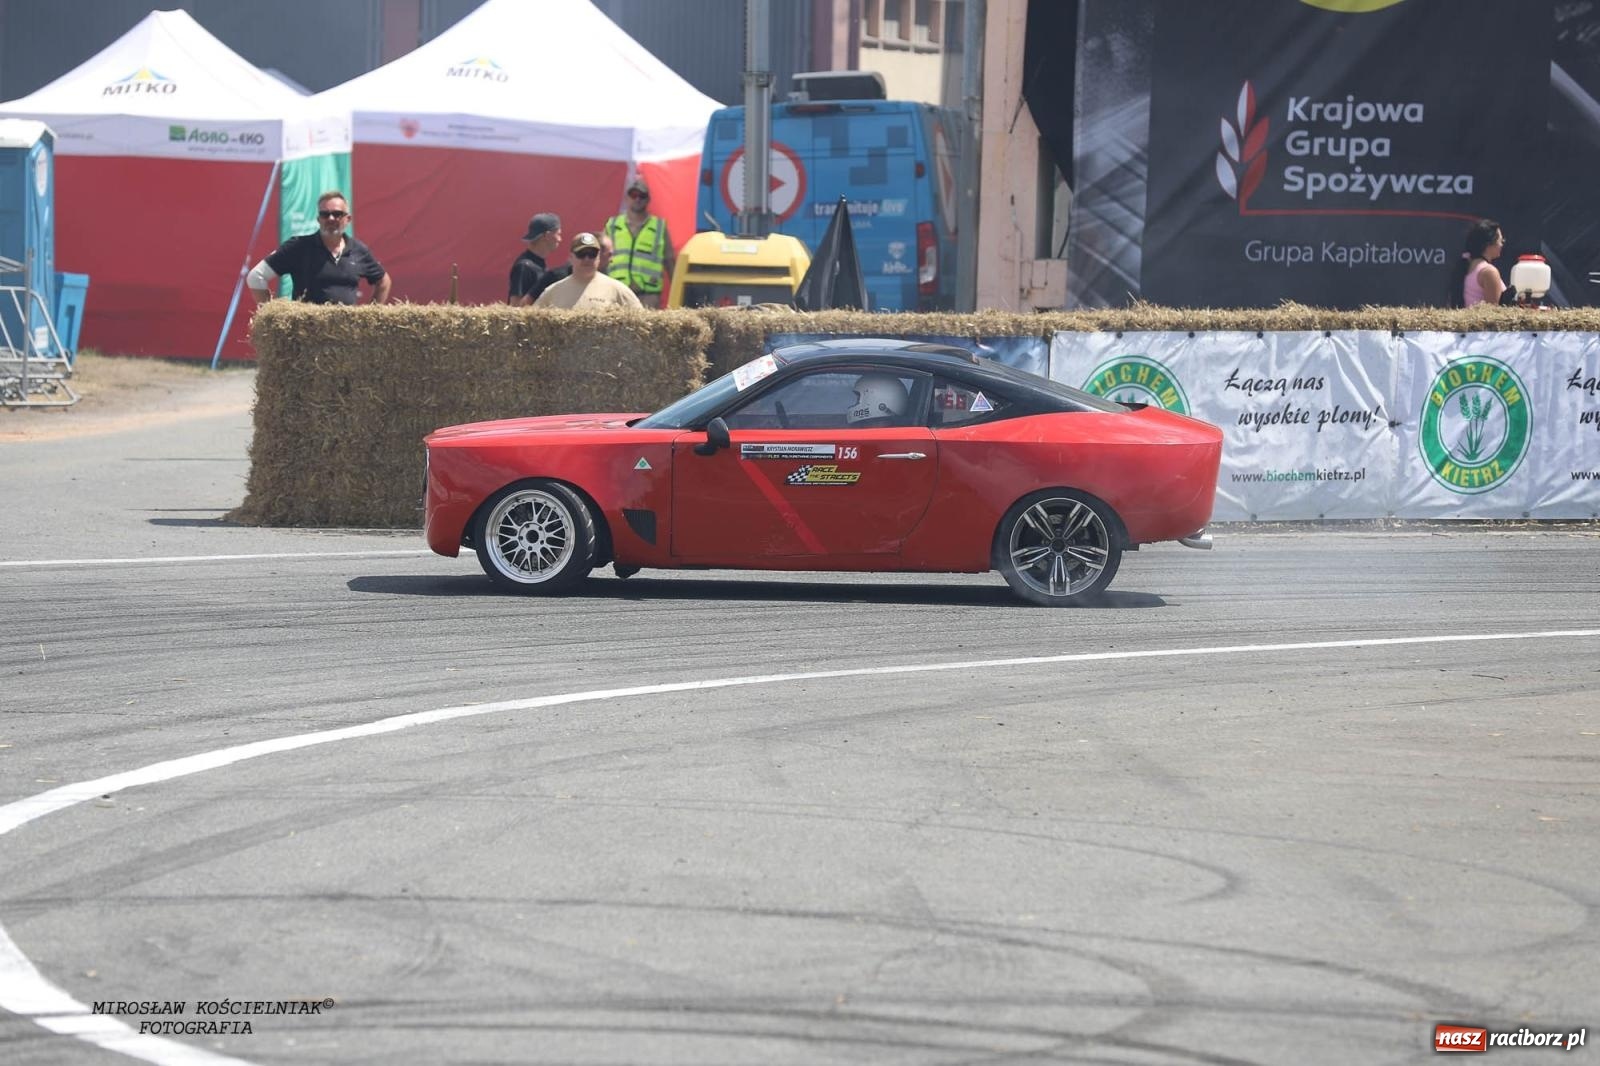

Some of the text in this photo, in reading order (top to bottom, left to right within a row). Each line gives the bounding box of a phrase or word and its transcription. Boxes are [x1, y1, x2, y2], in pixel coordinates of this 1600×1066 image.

[103, 82, 177, 96] MITKO
[446, 67, 509, 83] MITKO
[1287, 95, 1425, 129] Krajowa
[1285, 130, 1390, 163] Grupa
[1283, 166, 1474, 200] Spożywcza
[1245, 240, 1446, 268] Grupa Kapitałowa
[1094, 364, 1179, 408] IOCHEM
[1224, 368, 1324, 396] Łączą nas
[1430, 363, 1521, 407] BIOCHEM
[1238, 402, 1381, 432] wysokie plony!
[838, 447, 858, 459] 156
[1231, 468, 1366, 483] www.biochemkietrz.pl
[1441, 460, 1504, 487] KIETRZ
